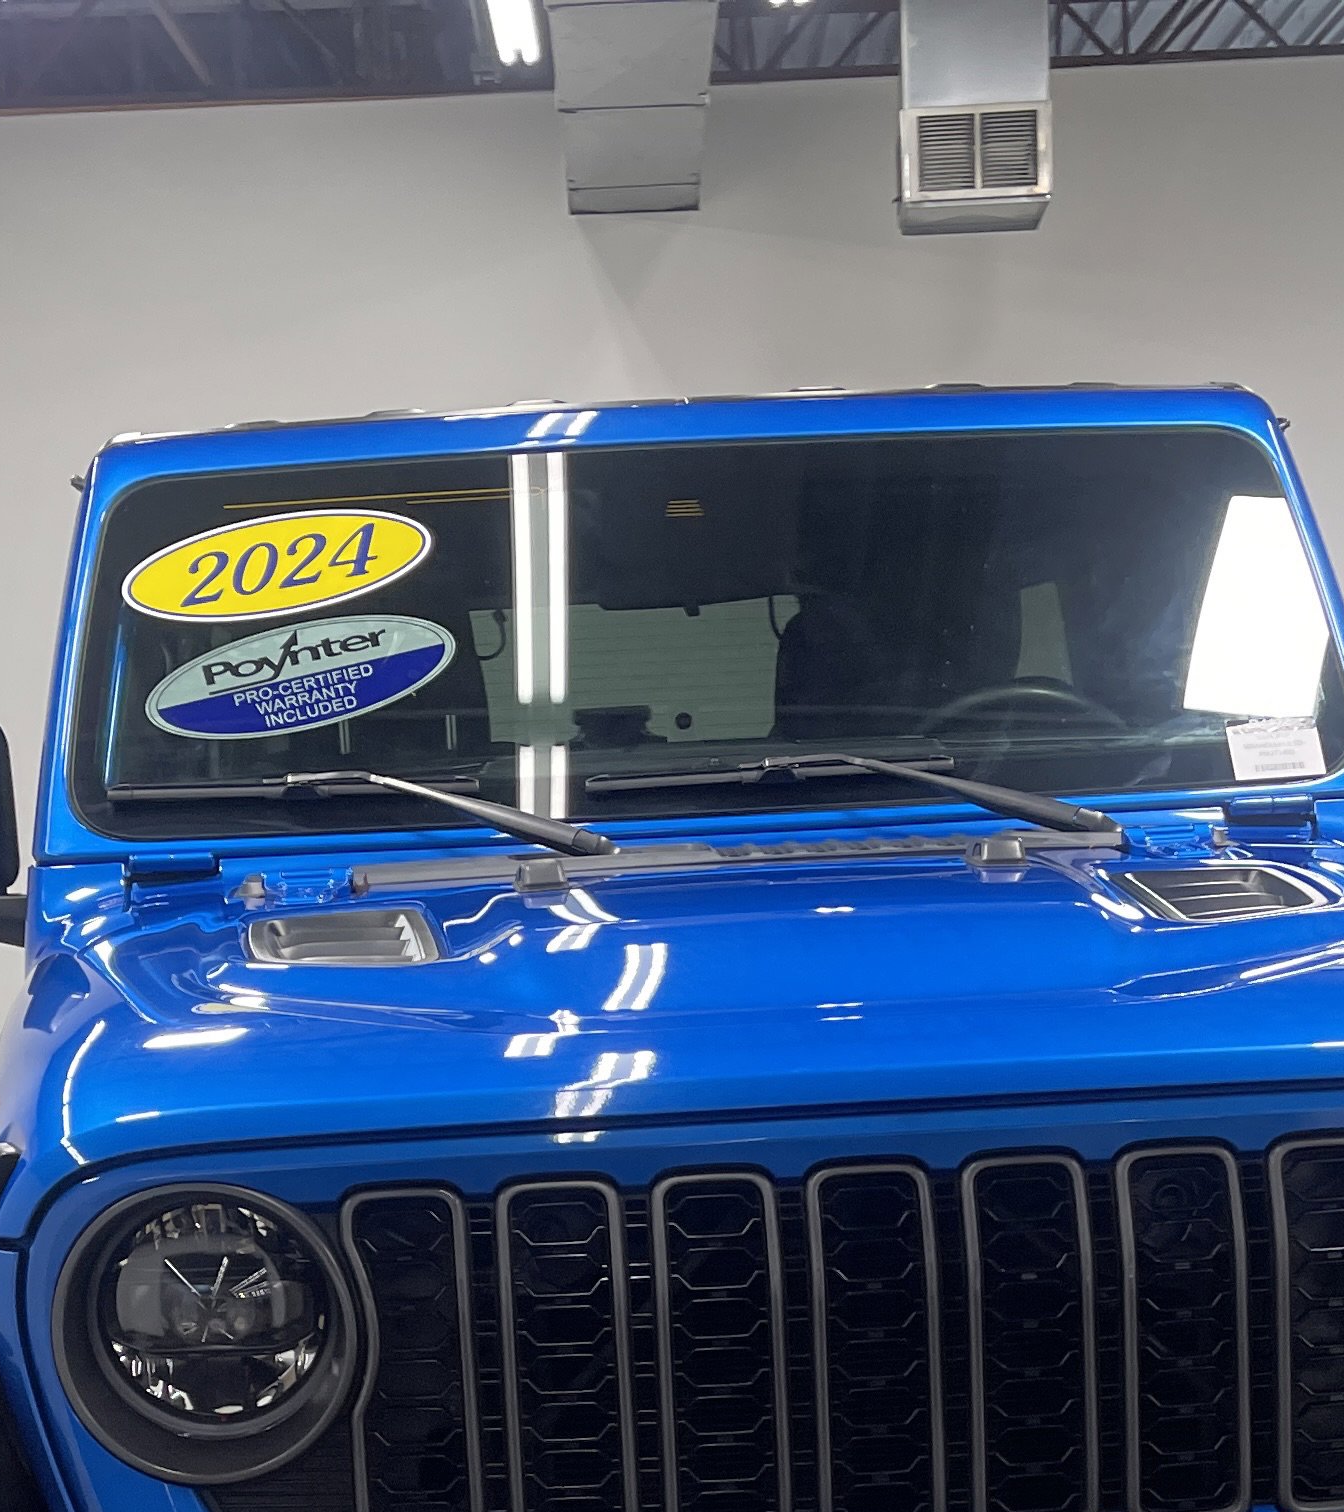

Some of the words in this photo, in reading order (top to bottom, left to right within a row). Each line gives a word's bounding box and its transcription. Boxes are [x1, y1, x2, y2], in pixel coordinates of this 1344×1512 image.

[180, 523, 377, 607] 2024
[202, 630, 386, 688] Poynter
[233, 663, 373, 707] PRO-CERTIFIED
[254, 681, 357, 716] WARRANTY
[264, 696, 357, 728] INCLUDED
